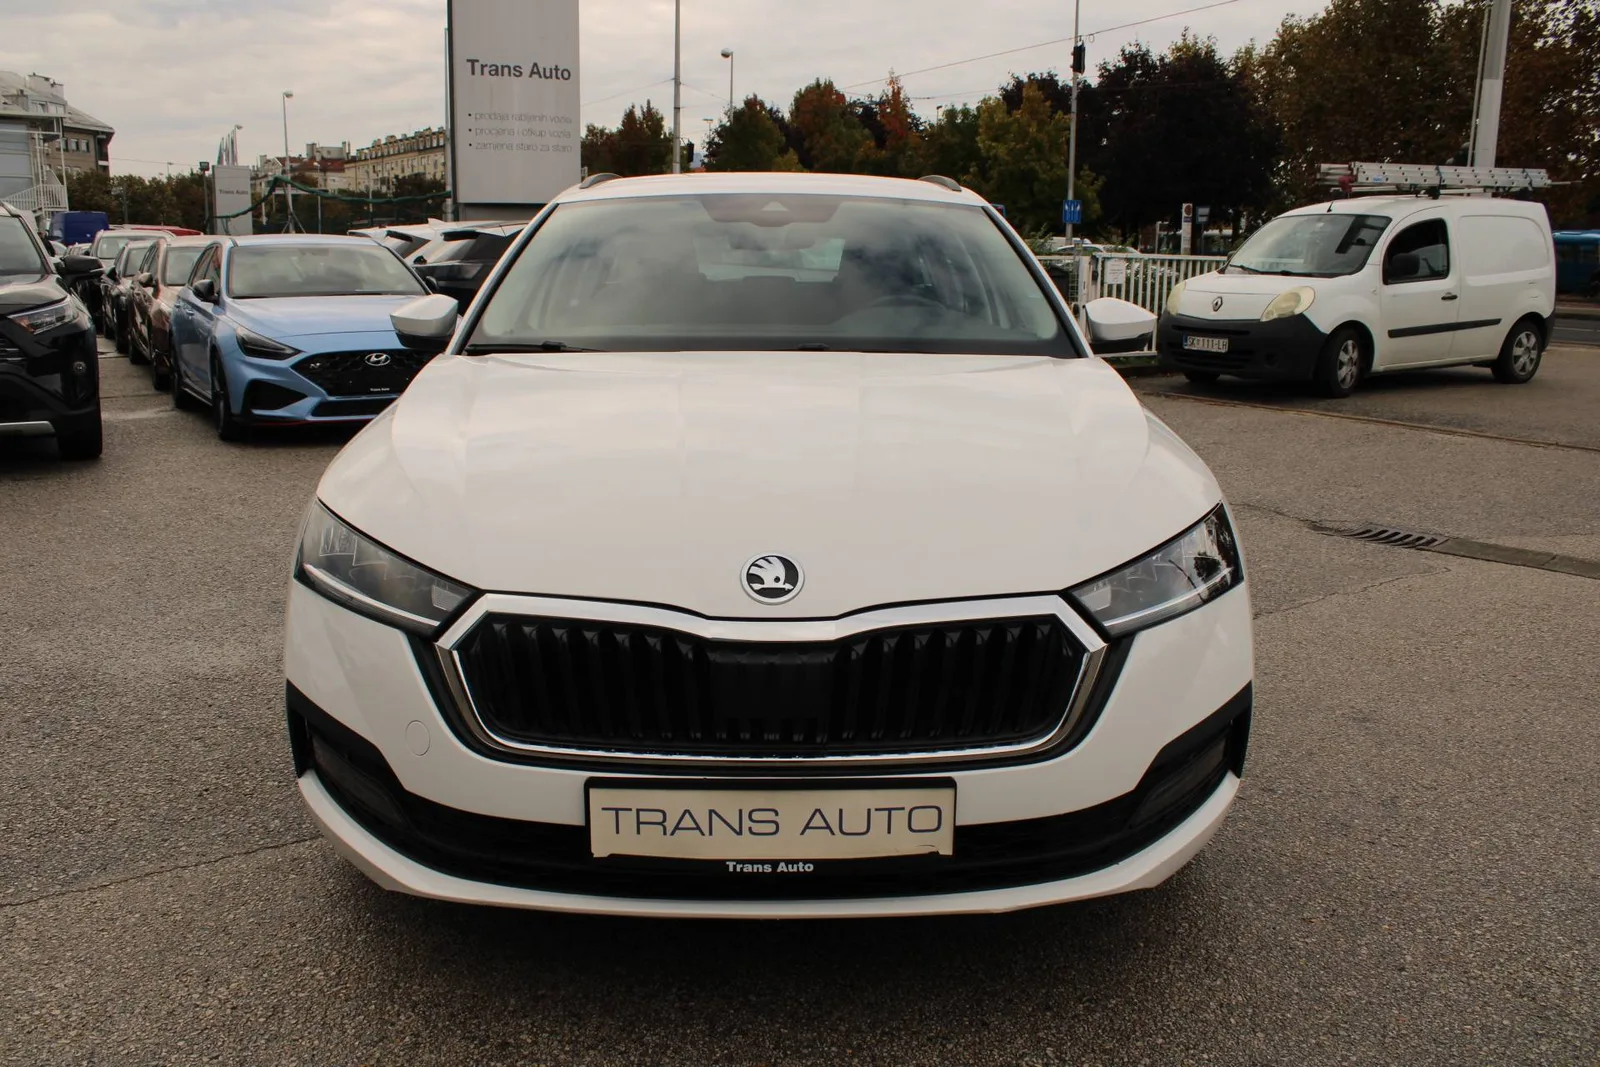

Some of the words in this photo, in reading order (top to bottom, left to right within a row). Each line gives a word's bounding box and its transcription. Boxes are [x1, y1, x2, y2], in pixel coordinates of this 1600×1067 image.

[466, 59, 523, 78] Trans
[528, 62, 571, 81] Auto
[601, 807, 780, 836] TRANS
[800, 805, 943, 836] AUTO
[726, 861, 772, 873] Trans
[777, 861, 814, 873] Auto
